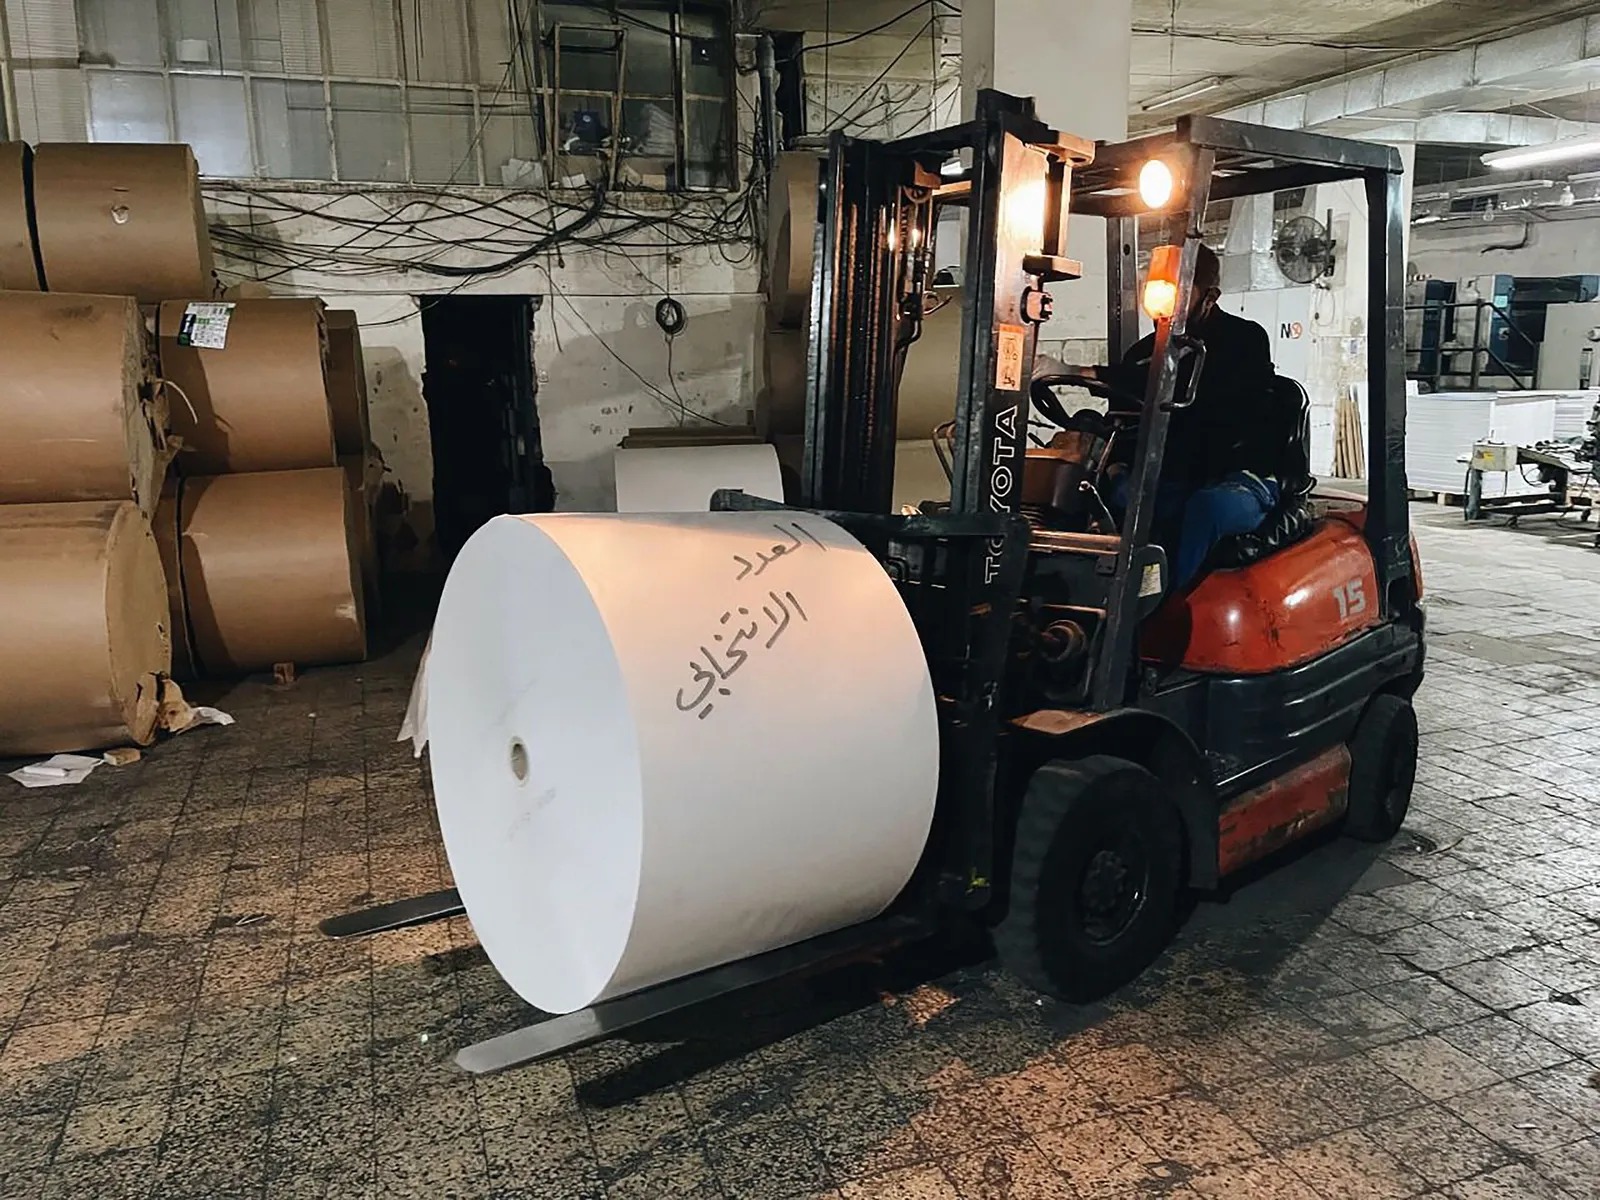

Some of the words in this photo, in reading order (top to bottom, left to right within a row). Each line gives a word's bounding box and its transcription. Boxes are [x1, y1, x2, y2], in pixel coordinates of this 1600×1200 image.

[733, 522, 827, 580] العدد
[1333, 578, 1366, 618] 15
[676, 591, 808, 720] الانتخابي
